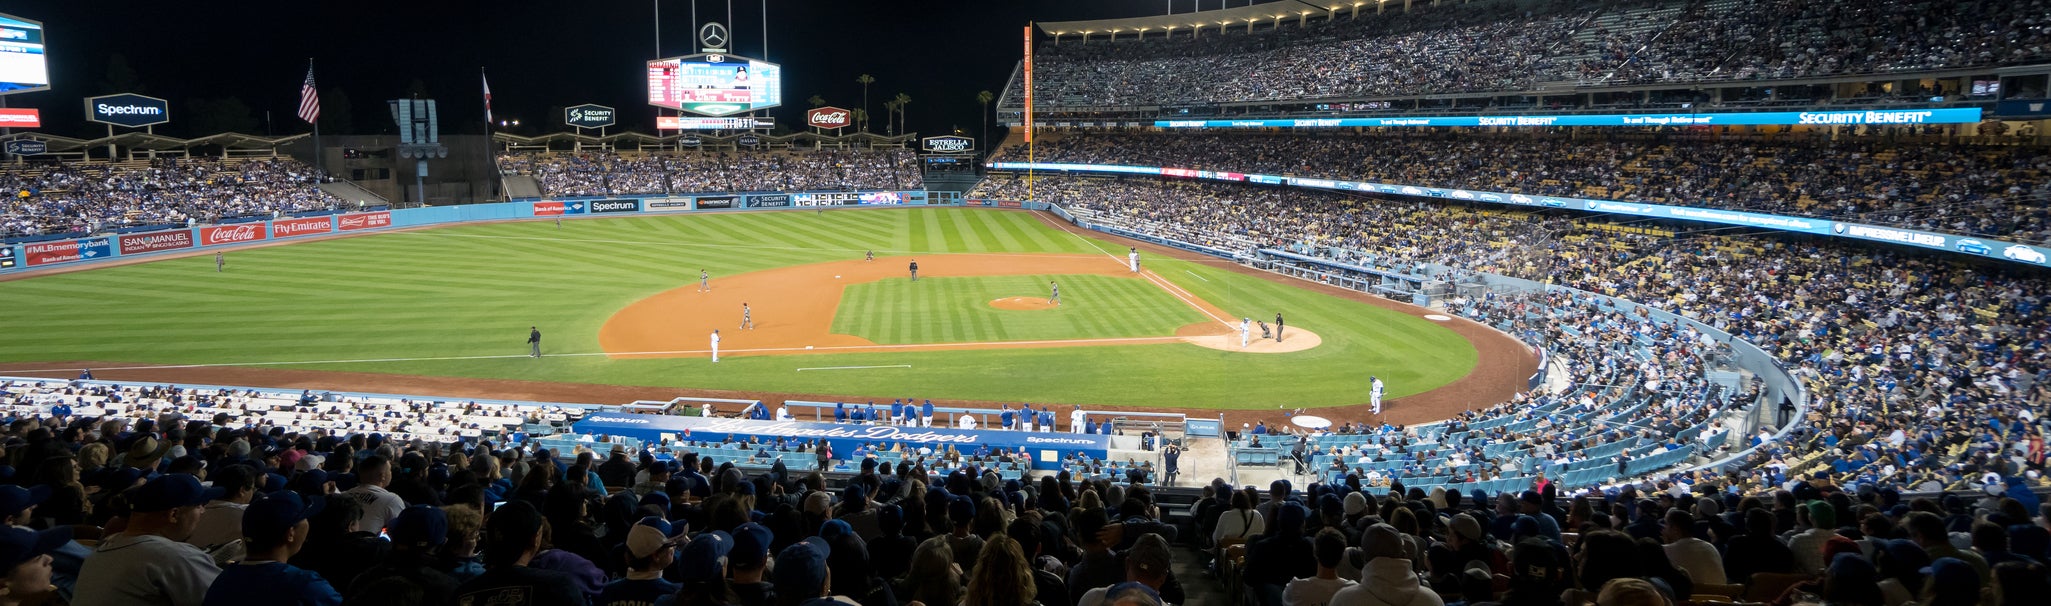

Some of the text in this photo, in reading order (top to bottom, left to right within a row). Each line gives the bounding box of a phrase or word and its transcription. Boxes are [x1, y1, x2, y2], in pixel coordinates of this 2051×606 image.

[98, 104, 159, 116] Spectrum
[812, 111, 847, 123] Coca-Cola
[1294, 119, 1318, 127] SECURITY
[1478, 116, 1517, 125] SECURITY
[1799, 112, 1864, 124] SECURITY
[593, 202, 634, 212] Spectrum
[274, 220, 330, 234] Fly Emirates
[123, 233, 189, 247] SAN MANUEL
[211, 225, 256, 243] Coca-Cola
[26, 239, 109, 254] #MLBmemorybank
[853, 426, 979, 443] Dodgers
[1027, 436, 1090, 444] Spectrum
